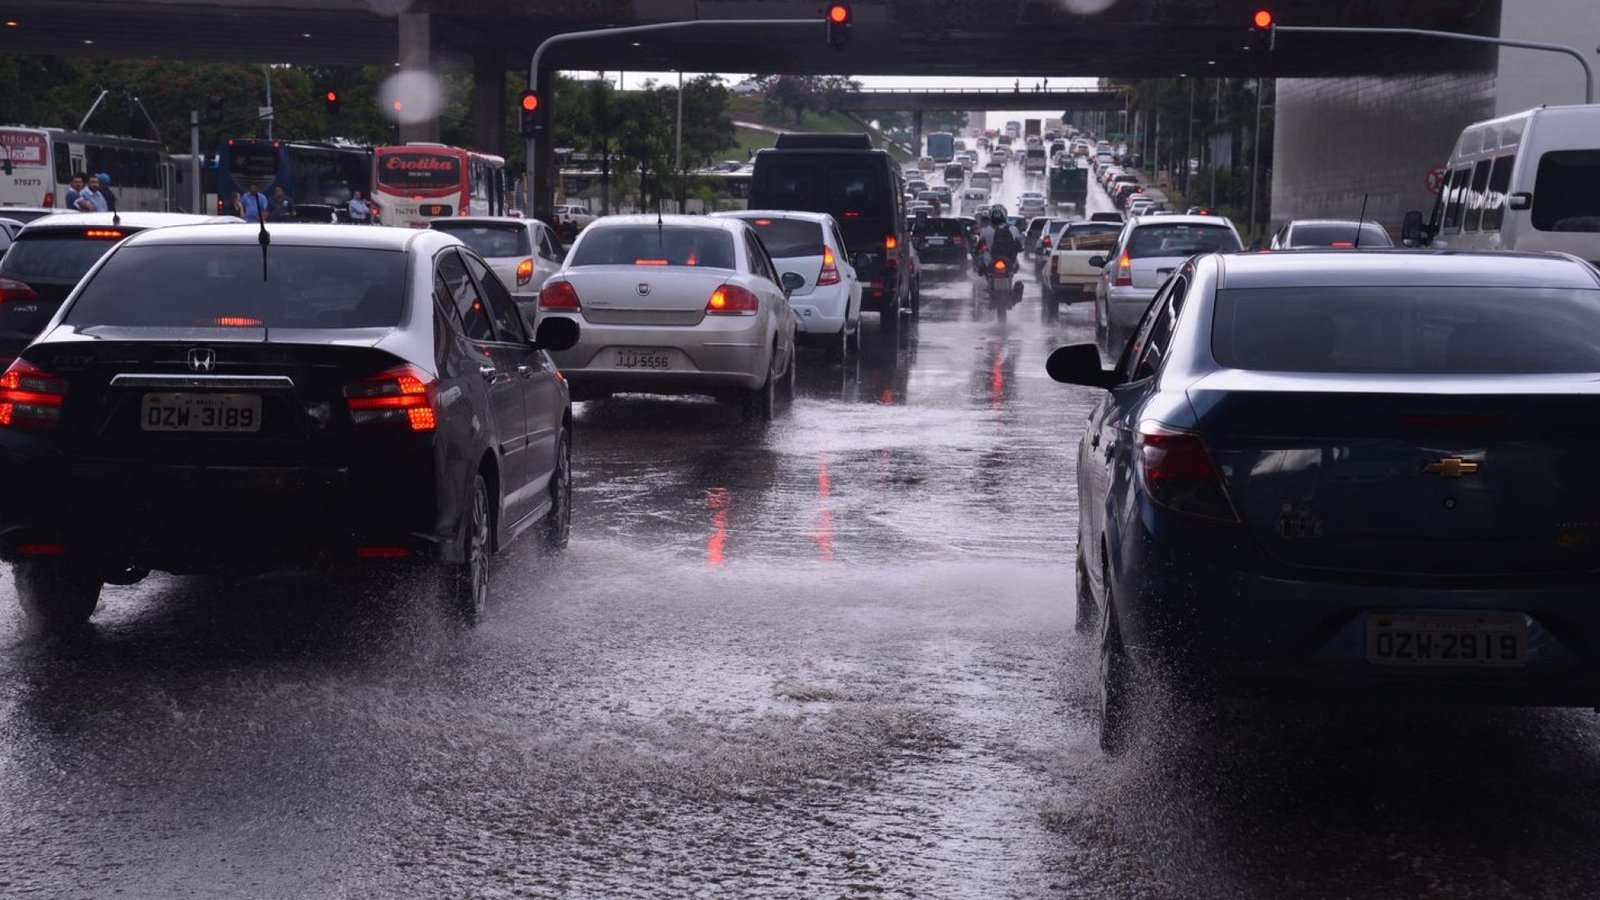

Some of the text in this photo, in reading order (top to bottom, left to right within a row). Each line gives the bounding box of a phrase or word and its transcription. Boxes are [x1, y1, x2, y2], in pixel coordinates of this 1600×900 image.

[0, 135, 39, 144] TIBULAR
[386, 157, 453, 170] Erotika
[148, 407, 253, 426] OZW-3189
[1377, 632, 1518, 659] OZW-2919
